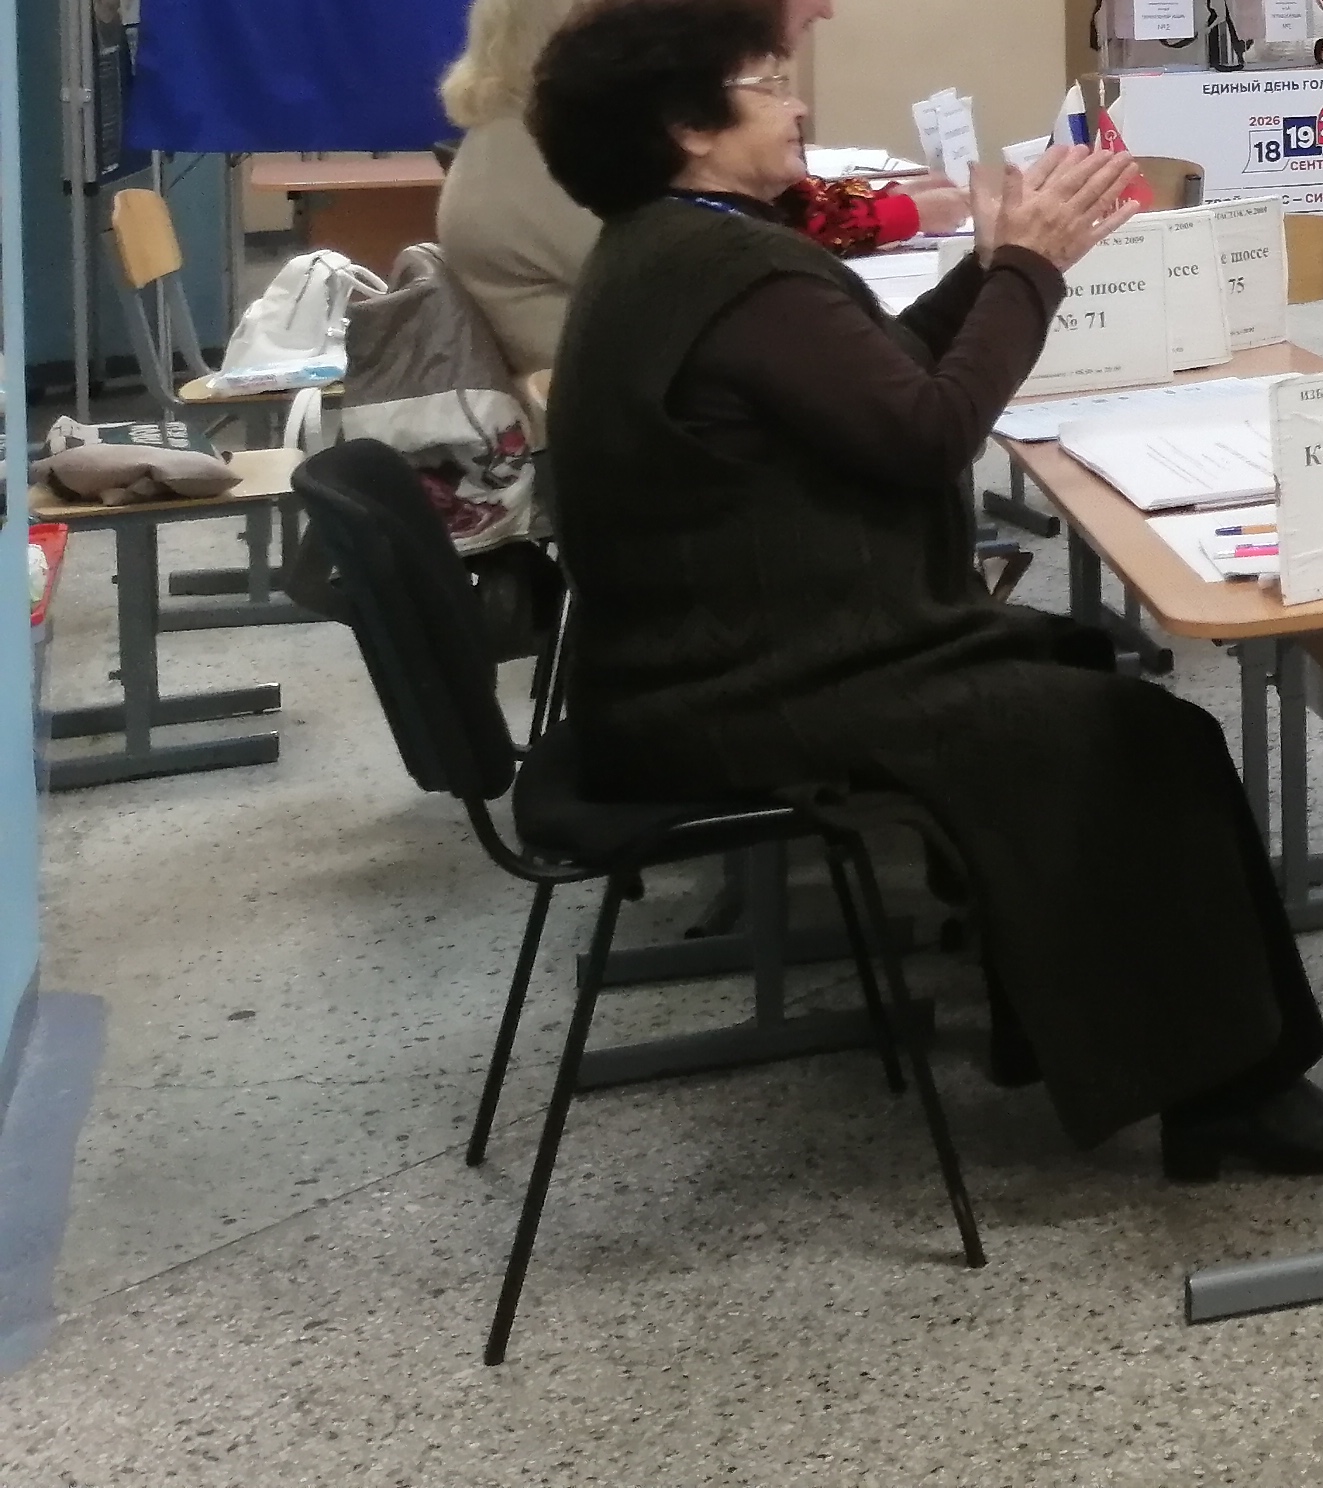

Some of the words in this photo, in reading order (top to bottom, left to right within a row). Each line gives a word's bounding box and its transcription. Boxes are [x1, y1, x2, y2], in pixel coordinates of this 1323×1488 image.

[1203, 79, 1260, 95] ЕДИНЫЙ
[1264, 80, 1299, 94] ДЕНЬ
[1249, 116, 1280, 126] 2026
[1287, 125, 1314, 149] 19
[1254, 141, 1281, 163] 18
[1125, 236, 1145, 245] 2009
[1231, 247, 1270, 263] шоссе
[1090, 280, 1147, 296] шоссе
[1228, 277, 1245, 294] 75
[1054, 312, 1078, 332] №
[1084, 311, 1106, 329] 71
